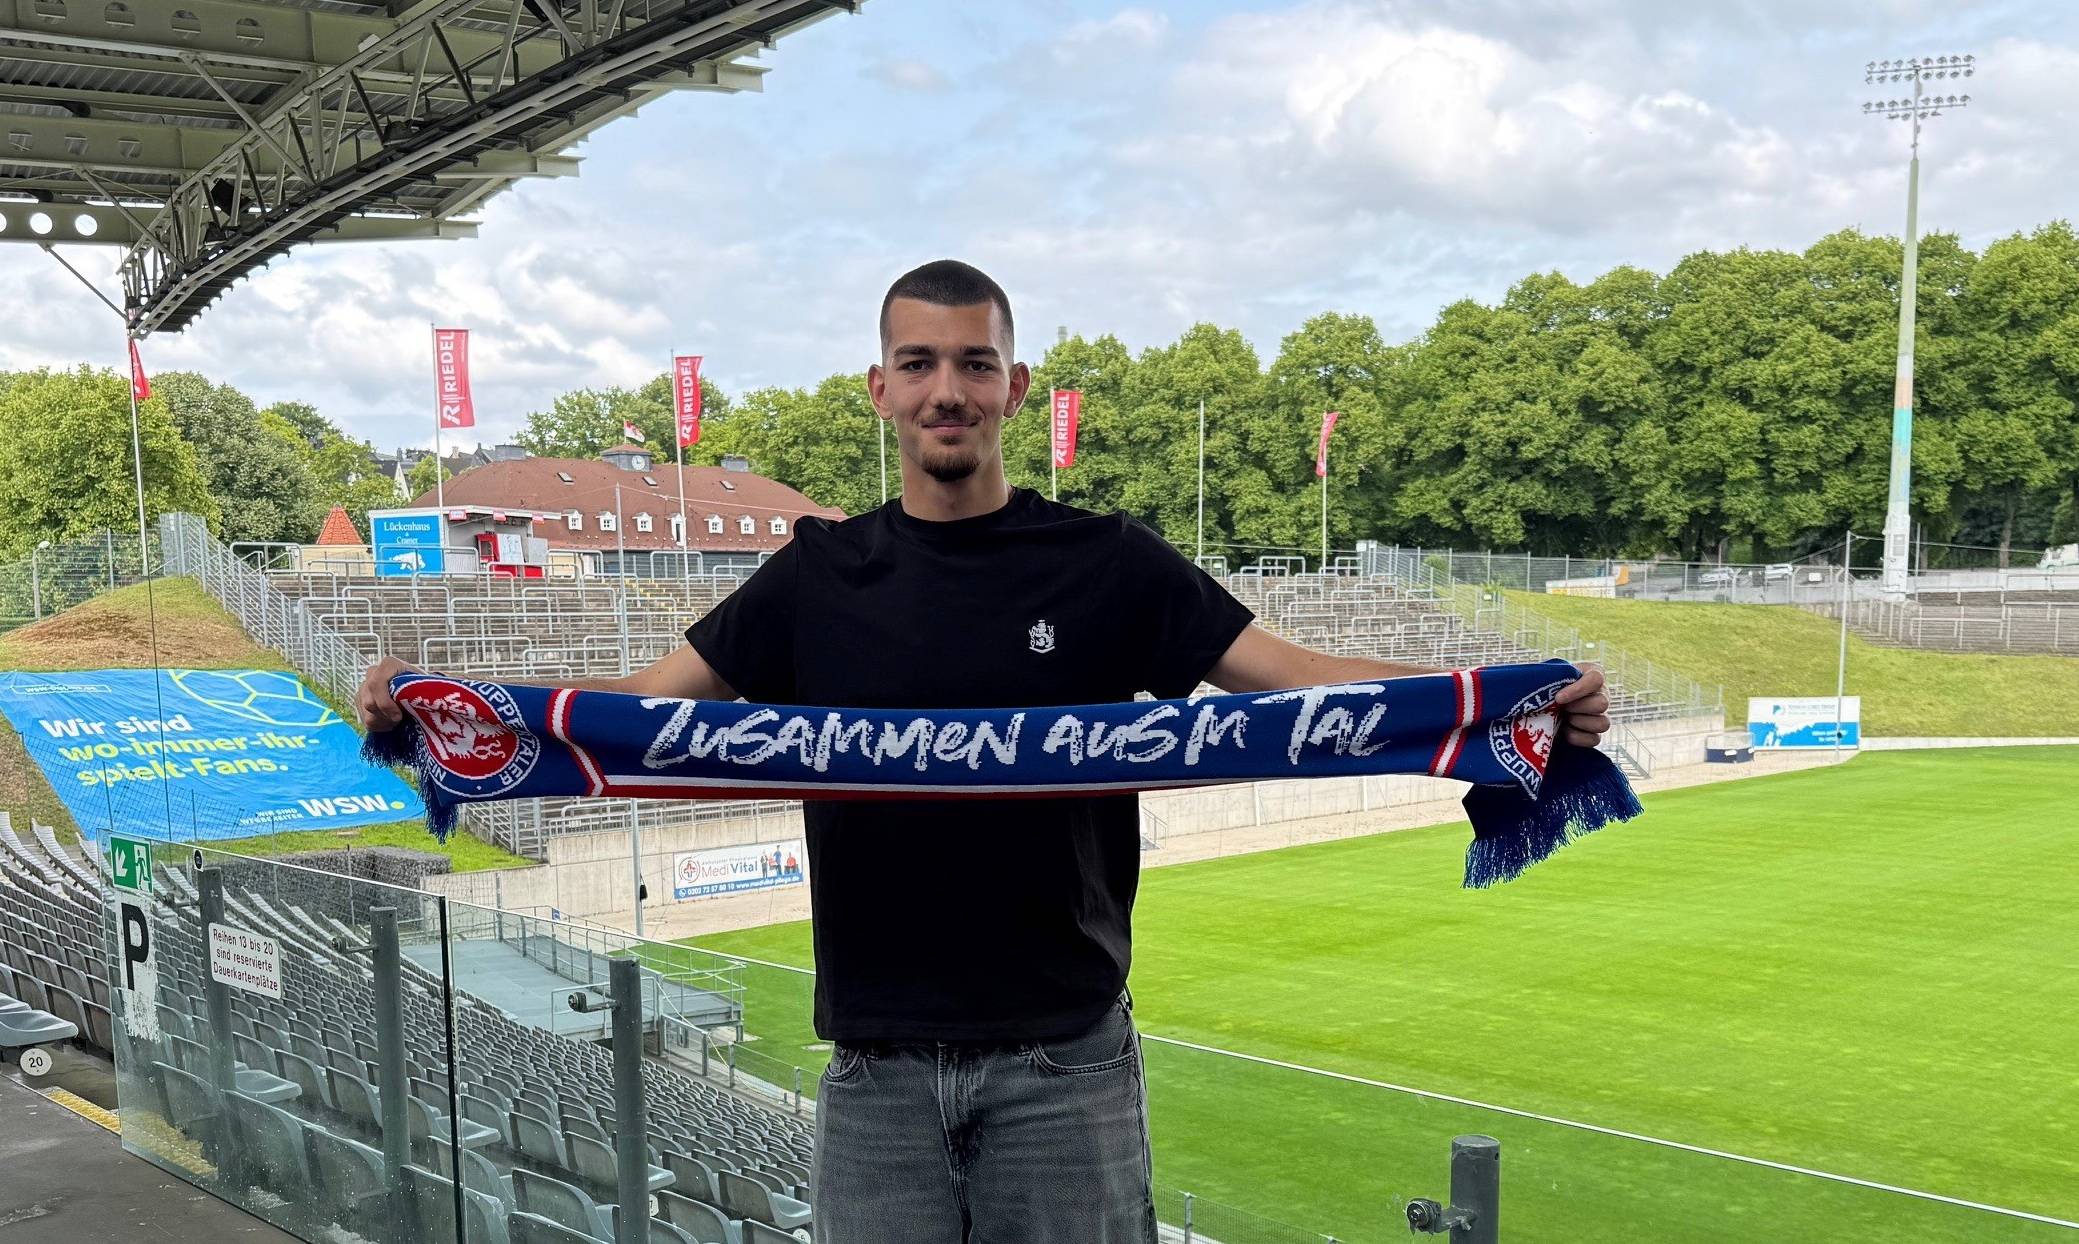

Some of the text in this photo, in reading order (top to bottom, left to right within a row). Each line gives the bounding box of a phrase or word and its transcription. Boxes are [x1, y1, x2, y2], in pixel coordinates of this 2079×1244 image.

[440, 331, 458, 393] RIEDEL
[680, 358, 694, 413] RIEDEL
[1056, 394, 1070, 440] RIEDEL
[384, 521, 430, 531] Lückenhaus
[39, 714, 193, 738] Wir sind
[59, 732, 320, 761] wo-immer-ihr-
[76, 756, 289, 788] spielt-Fans.
[730, 860, 758, 874] Vital
[121, 903, 149, 991] P
[213, 929, 274, 955] Reihen 13 bis 20
[216, 948, 273, 972] sind reservierte
[213, 961, 278, 991] Dauerkartenplätze
[28, 1057, 44, 1069] 20
